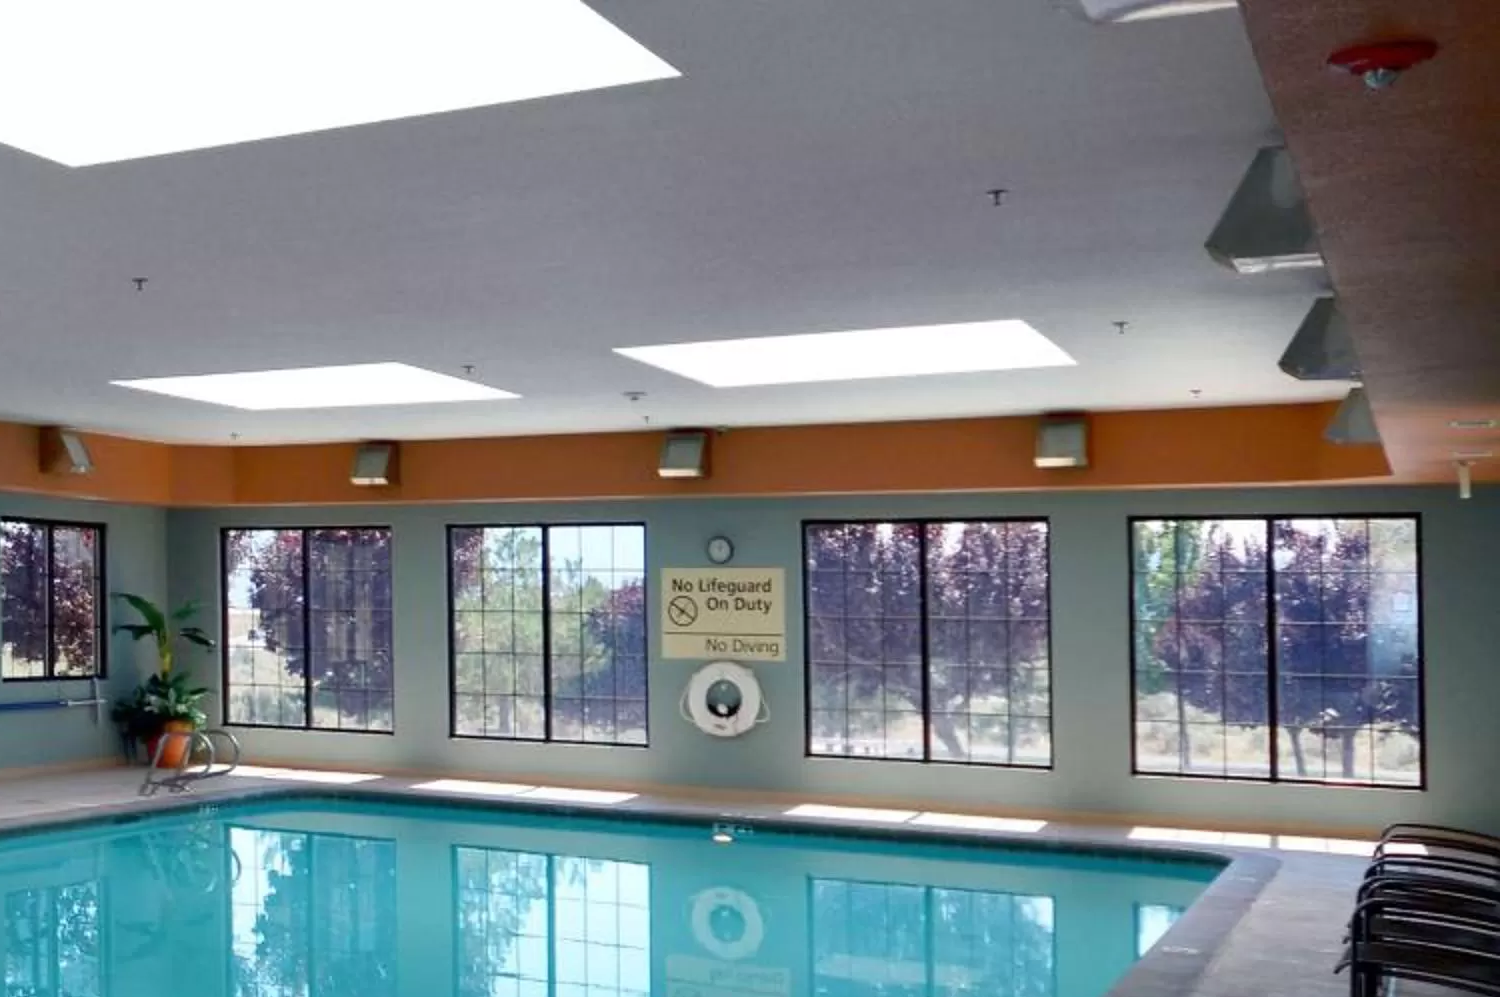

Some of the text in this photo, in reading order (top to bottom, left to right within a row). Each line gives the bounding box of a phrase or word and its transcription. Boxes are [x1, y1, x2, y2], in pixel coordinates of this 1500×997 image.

[672, 578, 772, 596] No Lifeguard
[707, 597, 772, 614] On Duty
[706, 639, 779, 656] No Diving
